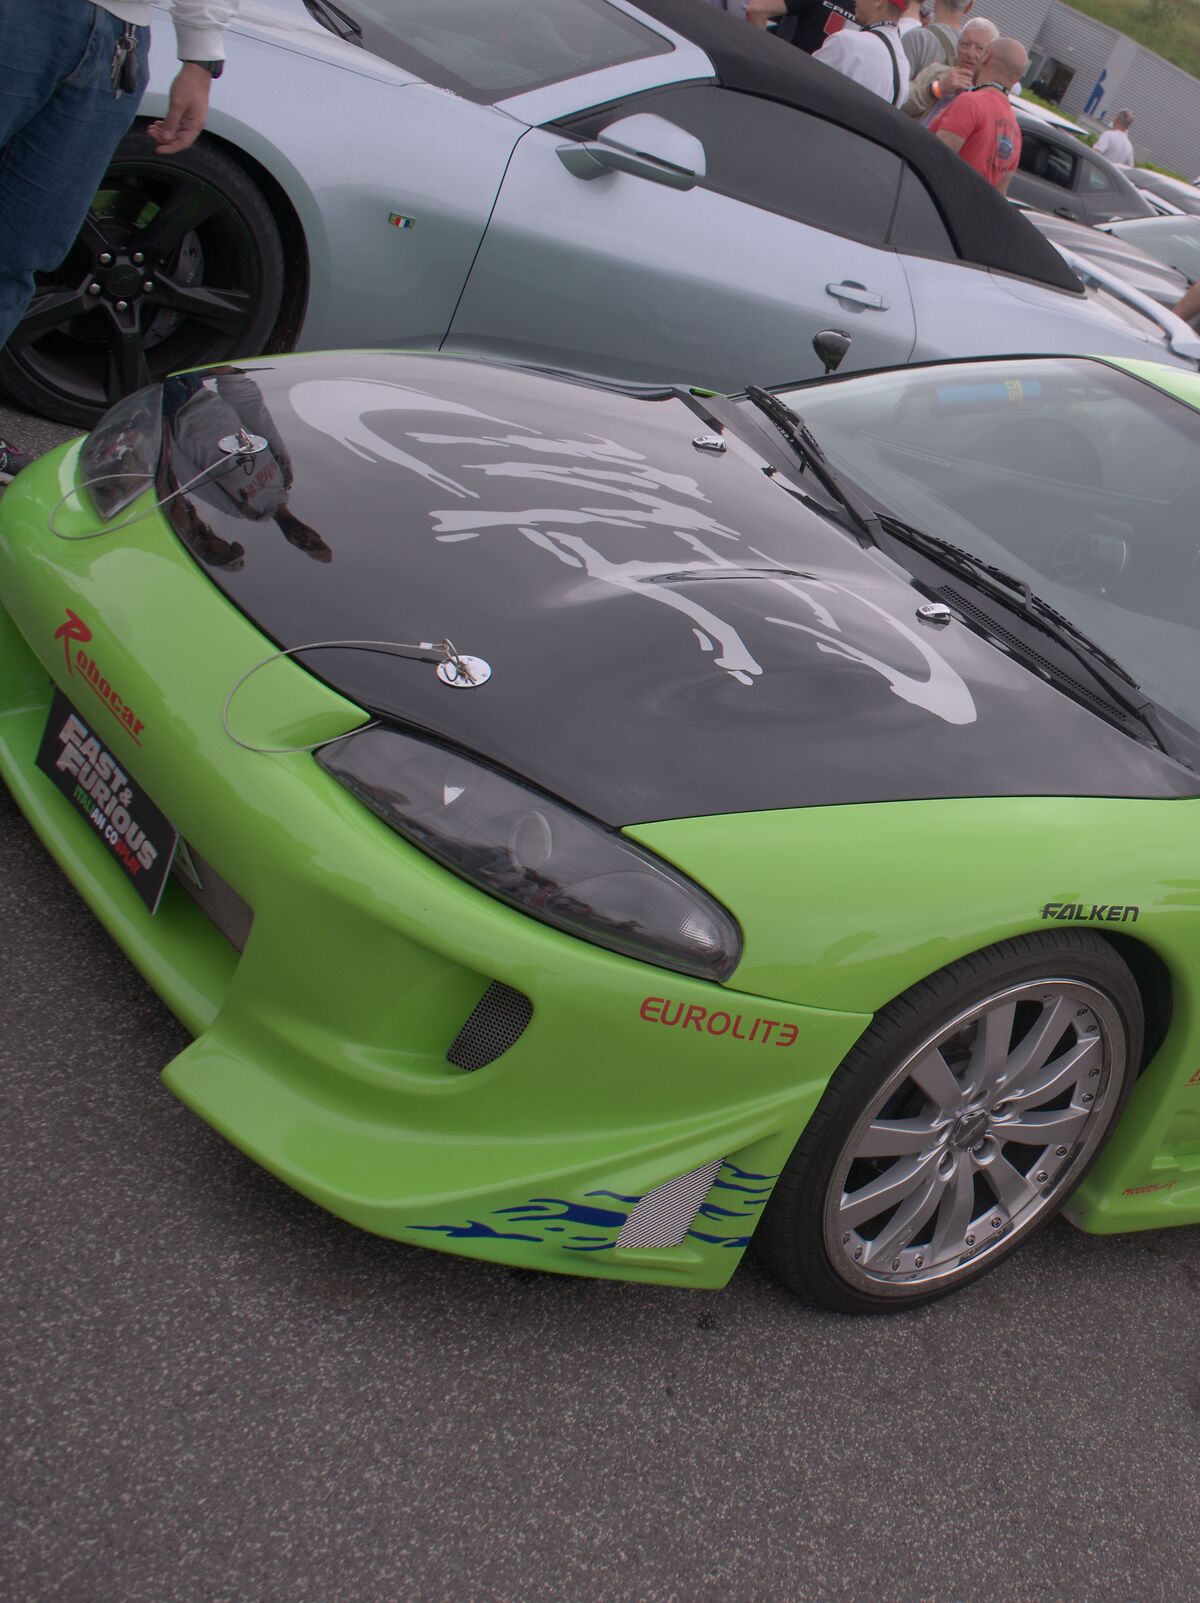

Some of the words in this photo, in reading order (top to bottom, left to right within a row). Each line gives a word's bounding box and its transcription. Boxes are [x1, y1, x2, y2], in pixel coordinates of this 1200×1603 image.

[822, 0, 857, 21] CAM
[54, 608, 145, 739] Robocar
[56, 742, 158, 870] FURIOUS
[58, 713, 128, 793] FAST
[118, 787, 133, 807] &
[1040, 902, 1139, 922] FALKEN
